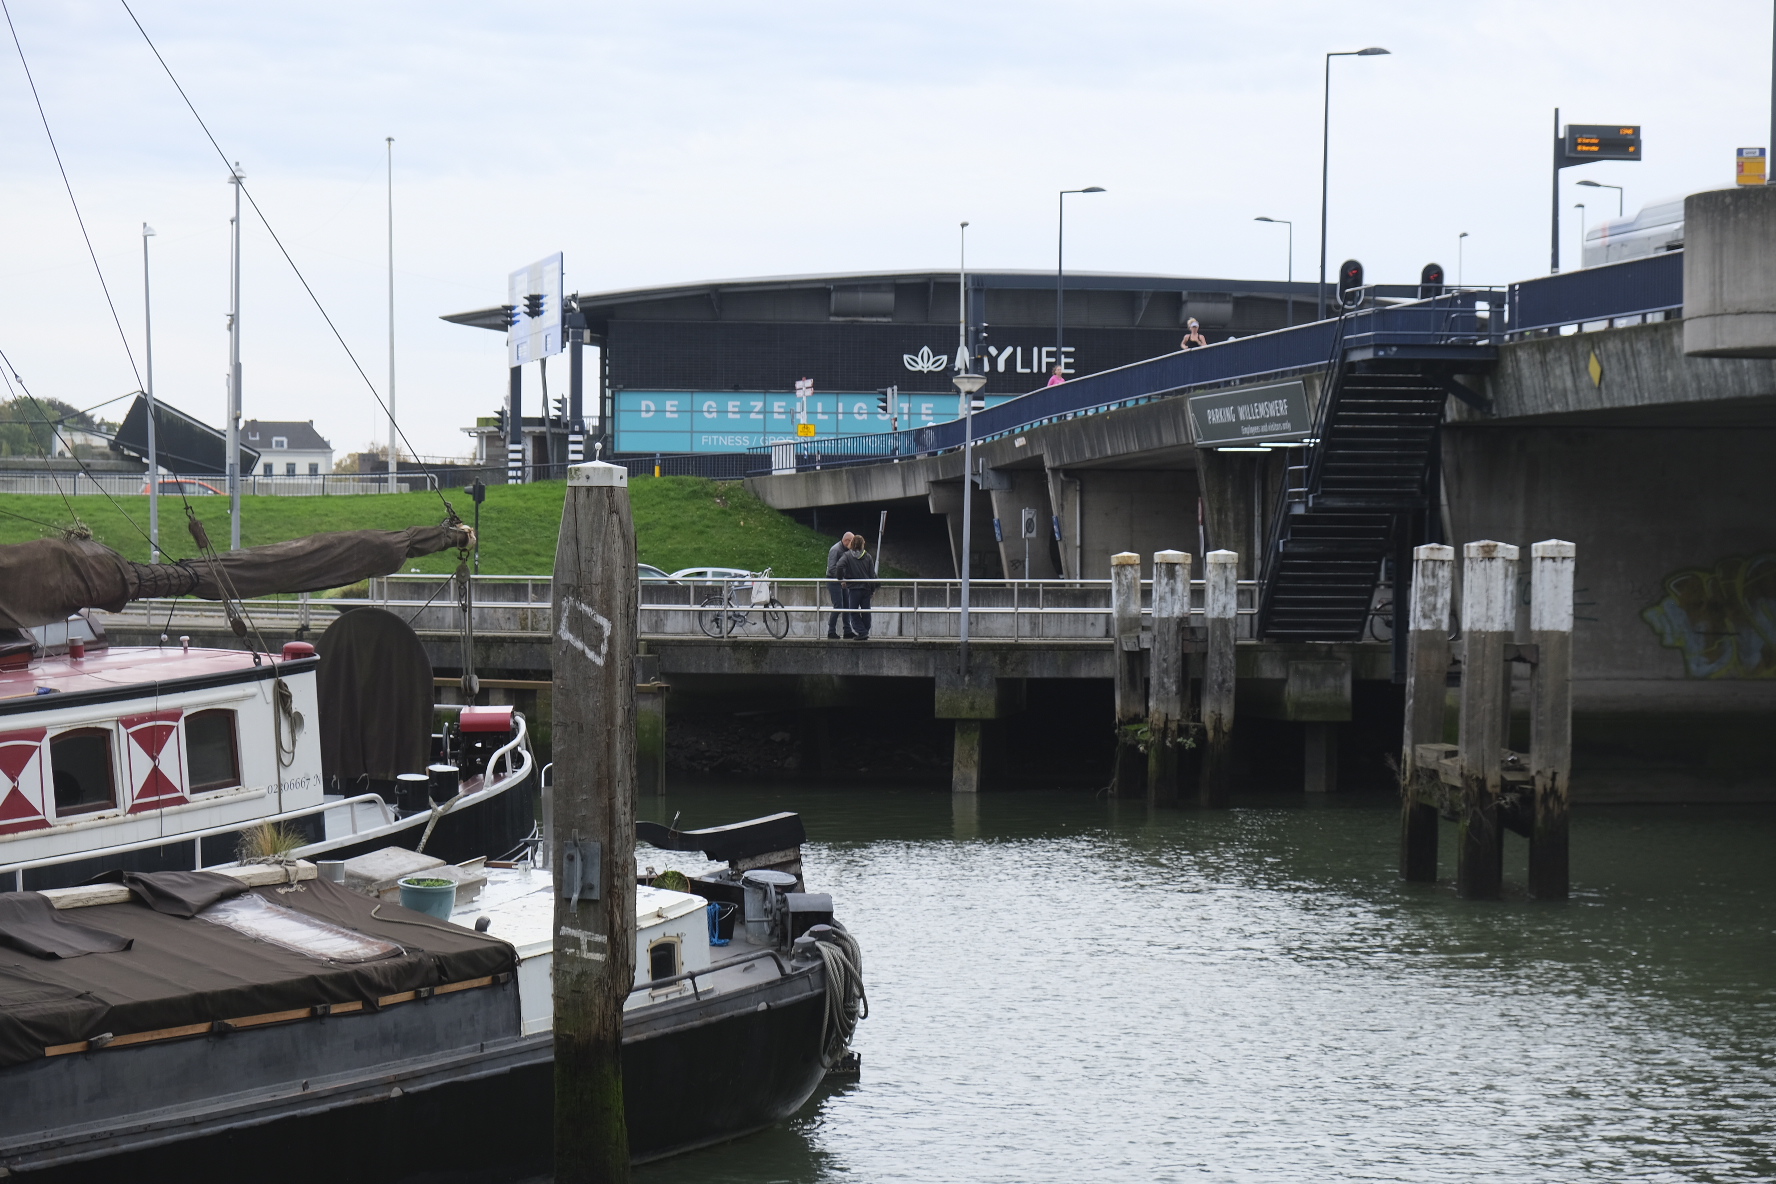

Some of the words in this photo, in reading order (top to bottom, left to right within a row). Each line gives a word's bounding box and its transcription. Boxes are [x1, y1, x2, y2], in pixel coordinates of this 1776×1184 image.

[640, 400, 679, 418] DE
[1207, 406, 1236, 424] PARKING
[1237, 399, 1288, 420] WILLEMSWERF
[701, 435, 749, 446] FITNESS
